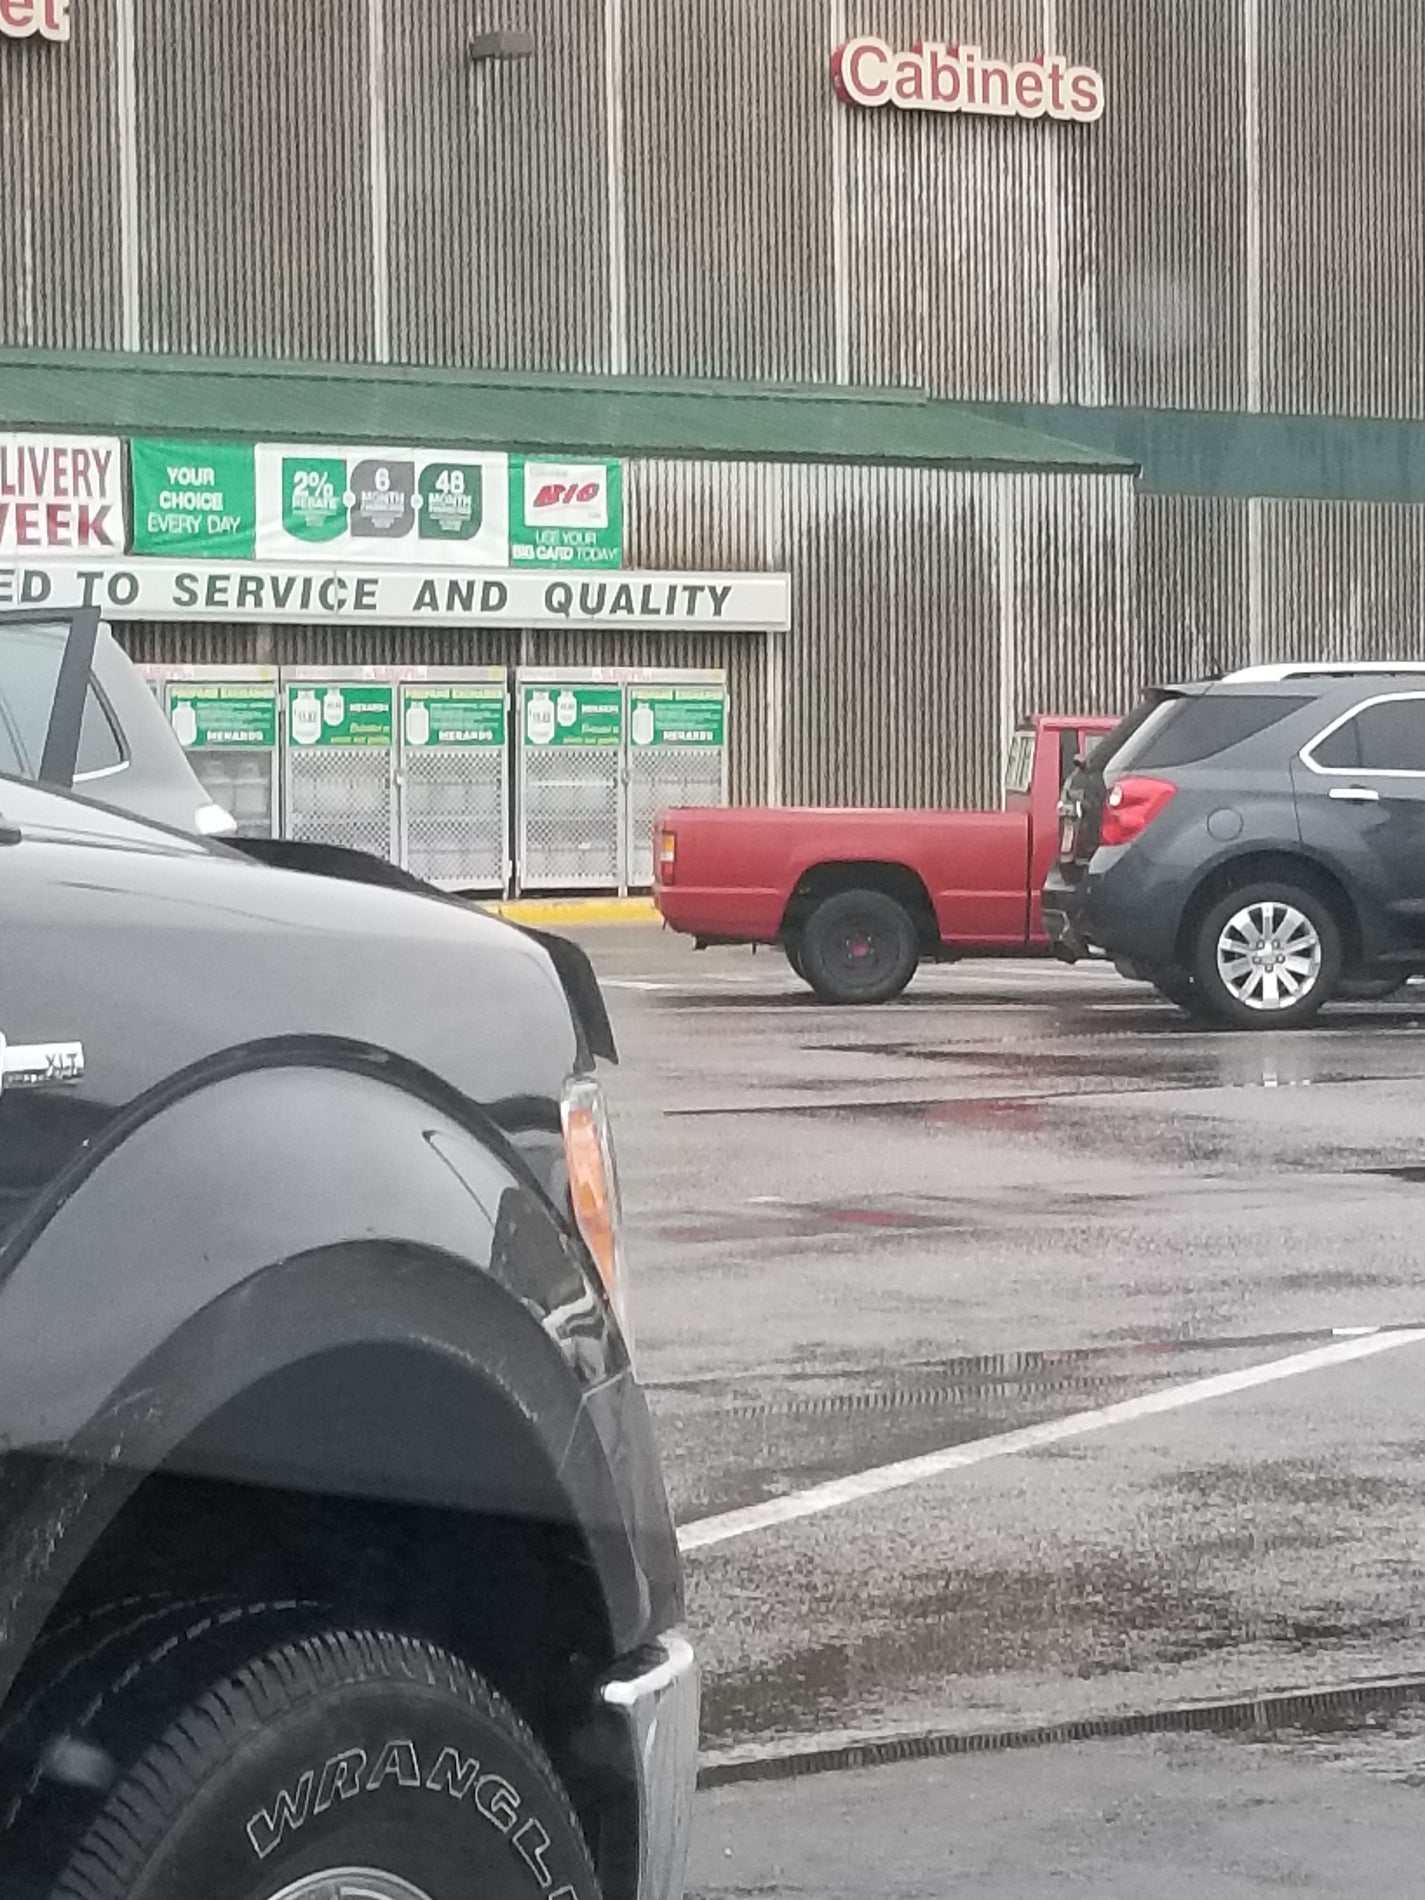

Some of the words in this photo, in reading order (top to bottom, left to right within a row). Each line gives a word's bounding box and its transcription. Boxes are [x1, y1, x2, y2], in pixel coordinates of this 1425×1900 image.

[848, 44, 1099, 113] Cabinets
[0, 446, 112, 498] LIVERY
[166, 466, 215, 485] YOUR
[293, 471, 334, 498] 2%
[375, 467, 390, 492] 6
[435, 470, 464, 494] 48
[159, 490, 224, 511] CHOICE
[147, 512, 202, 534] EVERY
[207, 515, 241, 534] DAY
[563, 531, 597, 545] YOUR
[77, 572, 140, 607] TO
[172, 573, 379, 611] SERVICE
[413, 579, 508, 613] AND
[545, 582, 732, 618] QUALITY
[245, 1739, 579, 1900] WRANGL
